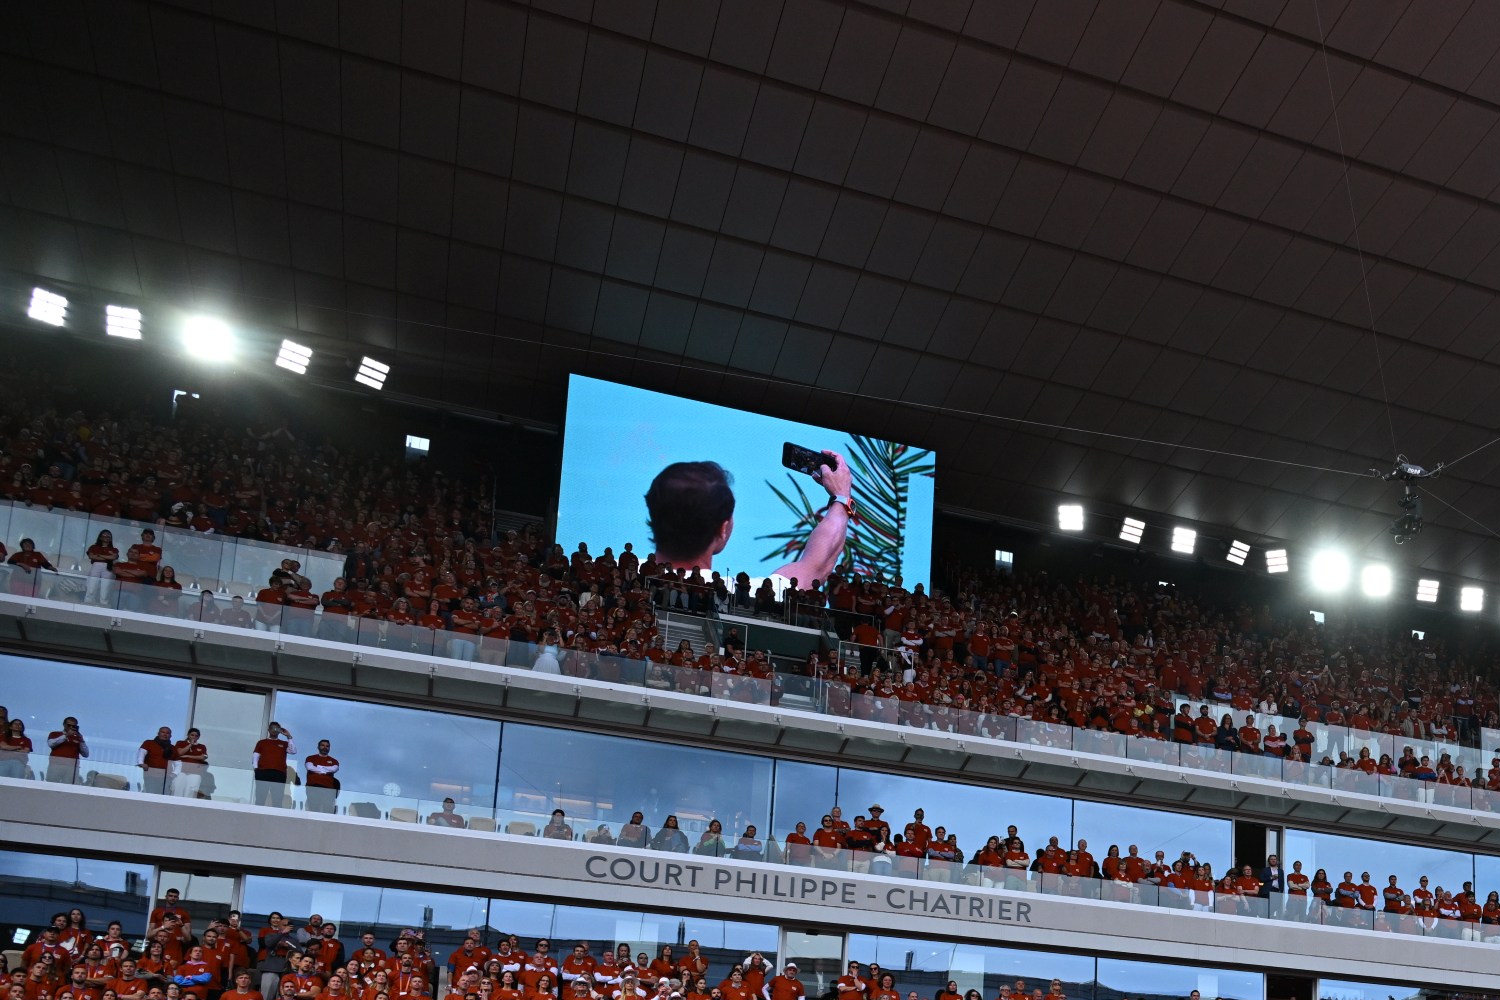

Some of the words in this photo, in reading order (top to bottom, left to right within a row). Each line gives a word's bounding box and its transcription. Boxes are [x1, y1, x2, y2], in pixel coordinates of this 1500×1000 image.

[585, 855, 703, 888] COURT
[714, 869, 857, 904] PHILIPPE
[886, 888, 1031, 923] CHATRIER
